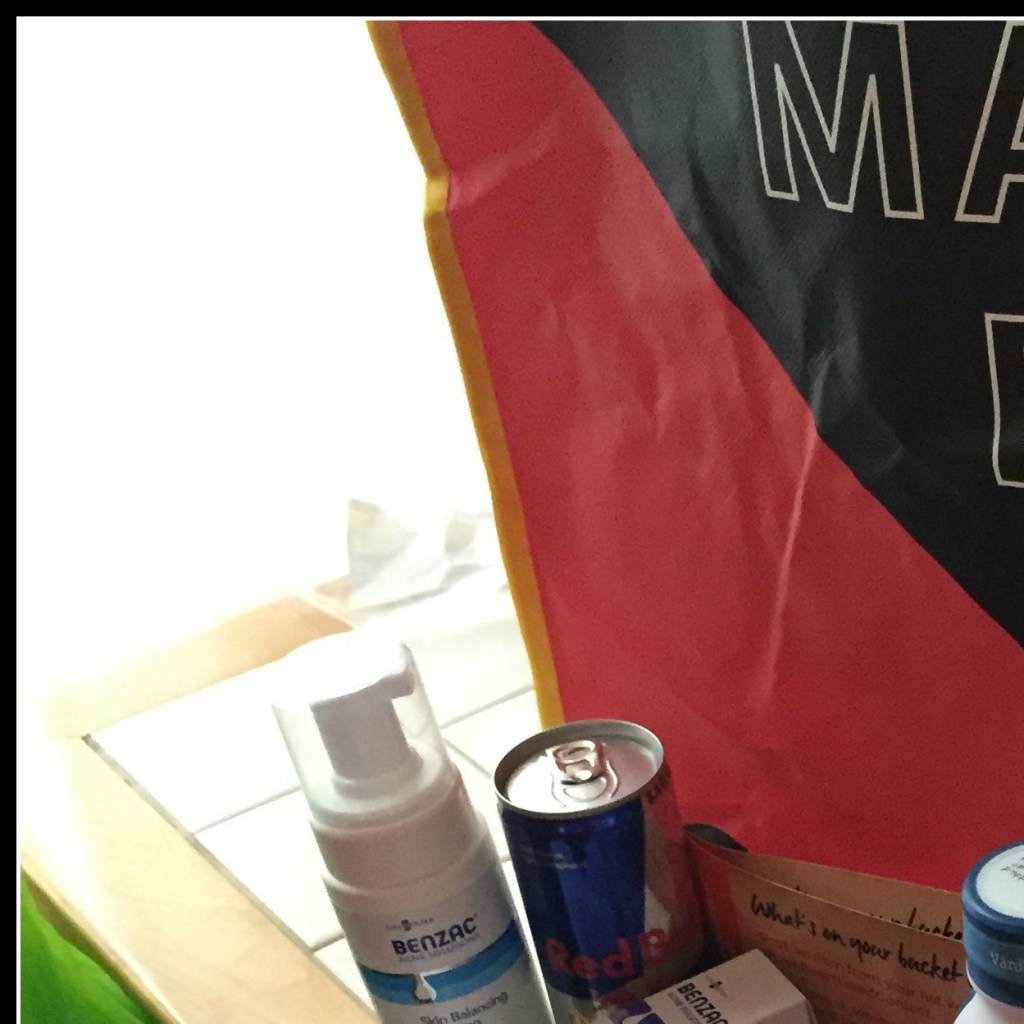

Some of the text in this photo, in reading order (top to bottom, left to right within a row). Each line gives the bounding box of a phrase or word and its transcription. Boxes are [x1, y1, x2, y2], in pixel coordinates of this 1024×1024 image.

[391, 917, 478, 956] BENZAC
[544, 934, 635, 980] Red
[751, 894, 963, 982] What's on your bucket
[450, 990, 509, 1024] Balancing
